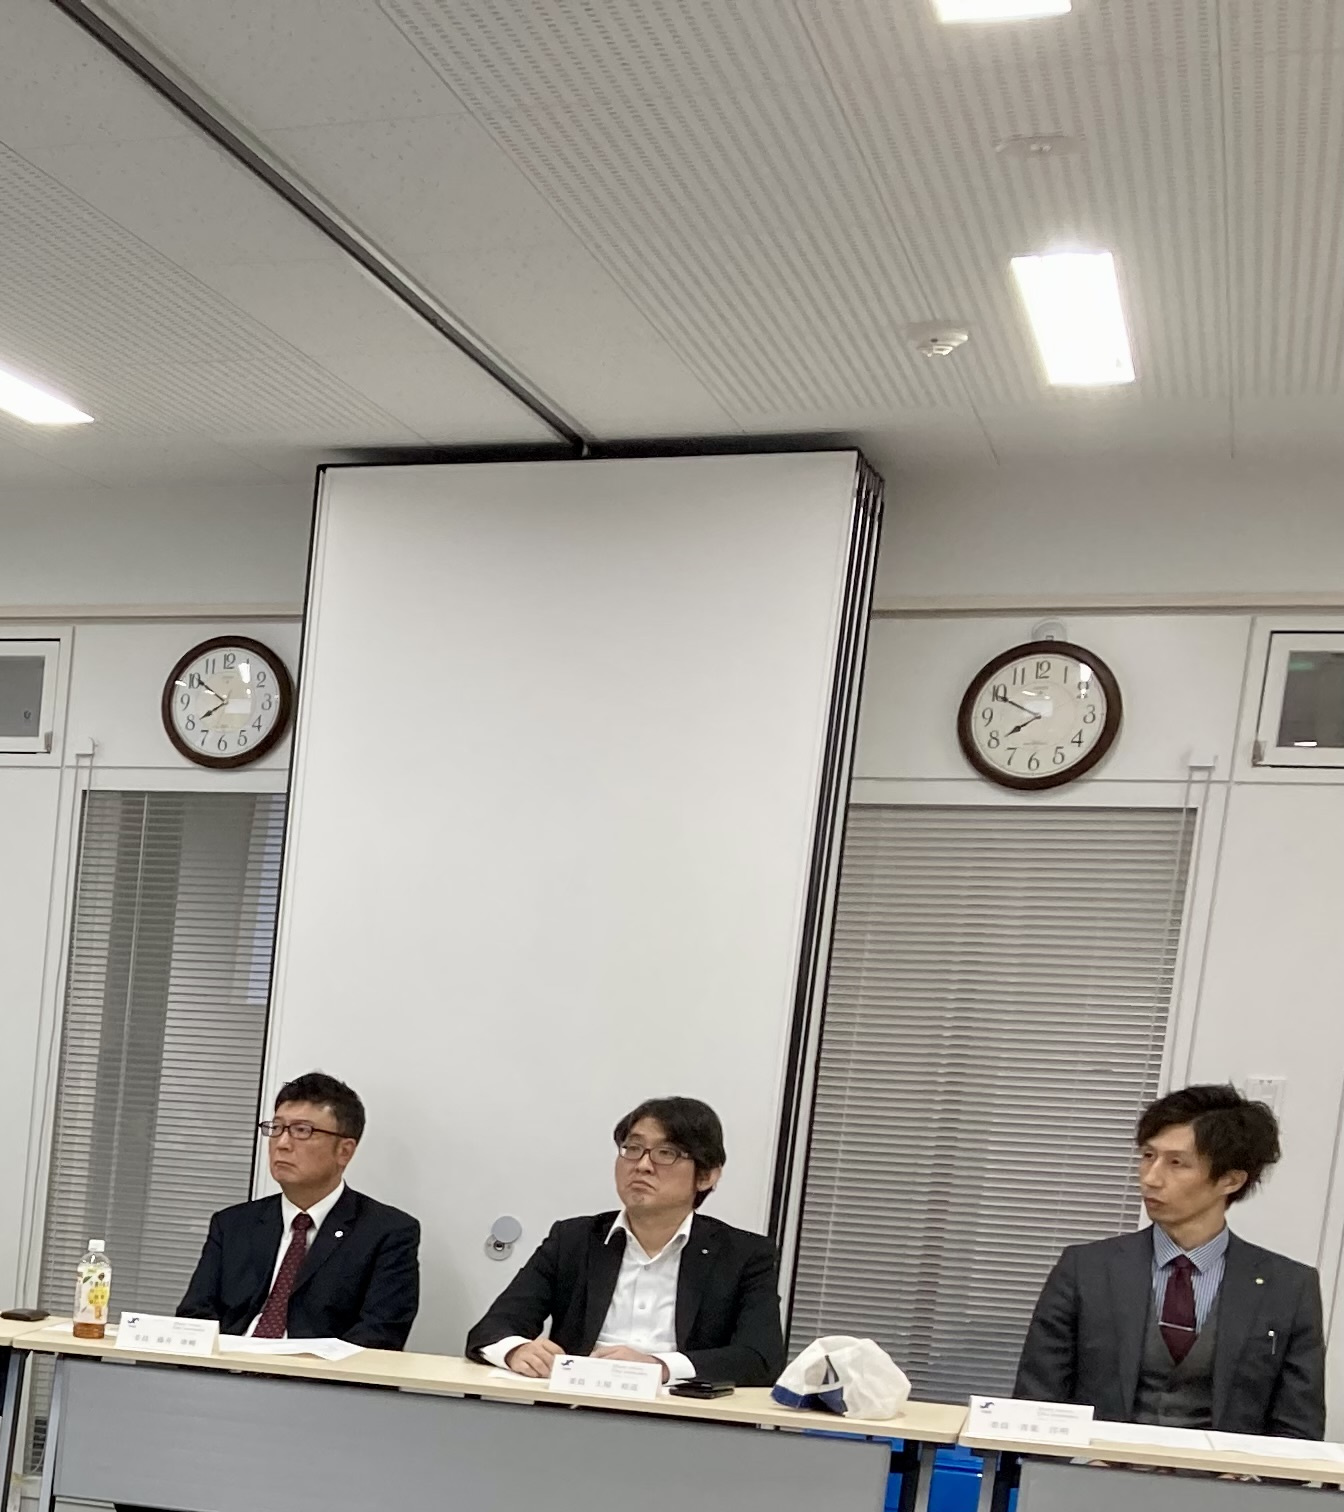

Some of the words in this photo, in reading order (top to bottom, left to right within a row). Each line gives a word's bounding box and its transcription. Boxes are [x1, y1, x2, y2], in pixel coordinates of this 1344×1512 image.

[205, 658, 216, 675] 11
[223, 653, 236, 670] 12
[1035, 660, 1051, 680] 12
[256, 671, 267, 688] 2
[1012, 667, 1026, 686] 11
[1063, 665, 1069, 685] 1
[180, 693, 191, 711] 9
[261, 693, 272, 711] 3
[185, 714, 196, 731] 8
[252, 714, 263, 732] 4
[981, 707, 994, 728] 9
[1083, 704, 1096, 724] 3
[200, 729, 209, 747] 7
[217, 734, 228, 752] 6
[237, 729, 248, 747] 5
[987, 730, 1000, 749] 8
[1071, 729, 1084, 748] 4
[1004, 747, 1018, 766] 7
[1027, 752, 1040, 771] 6
[1052, 746, 1065, 765] 5
